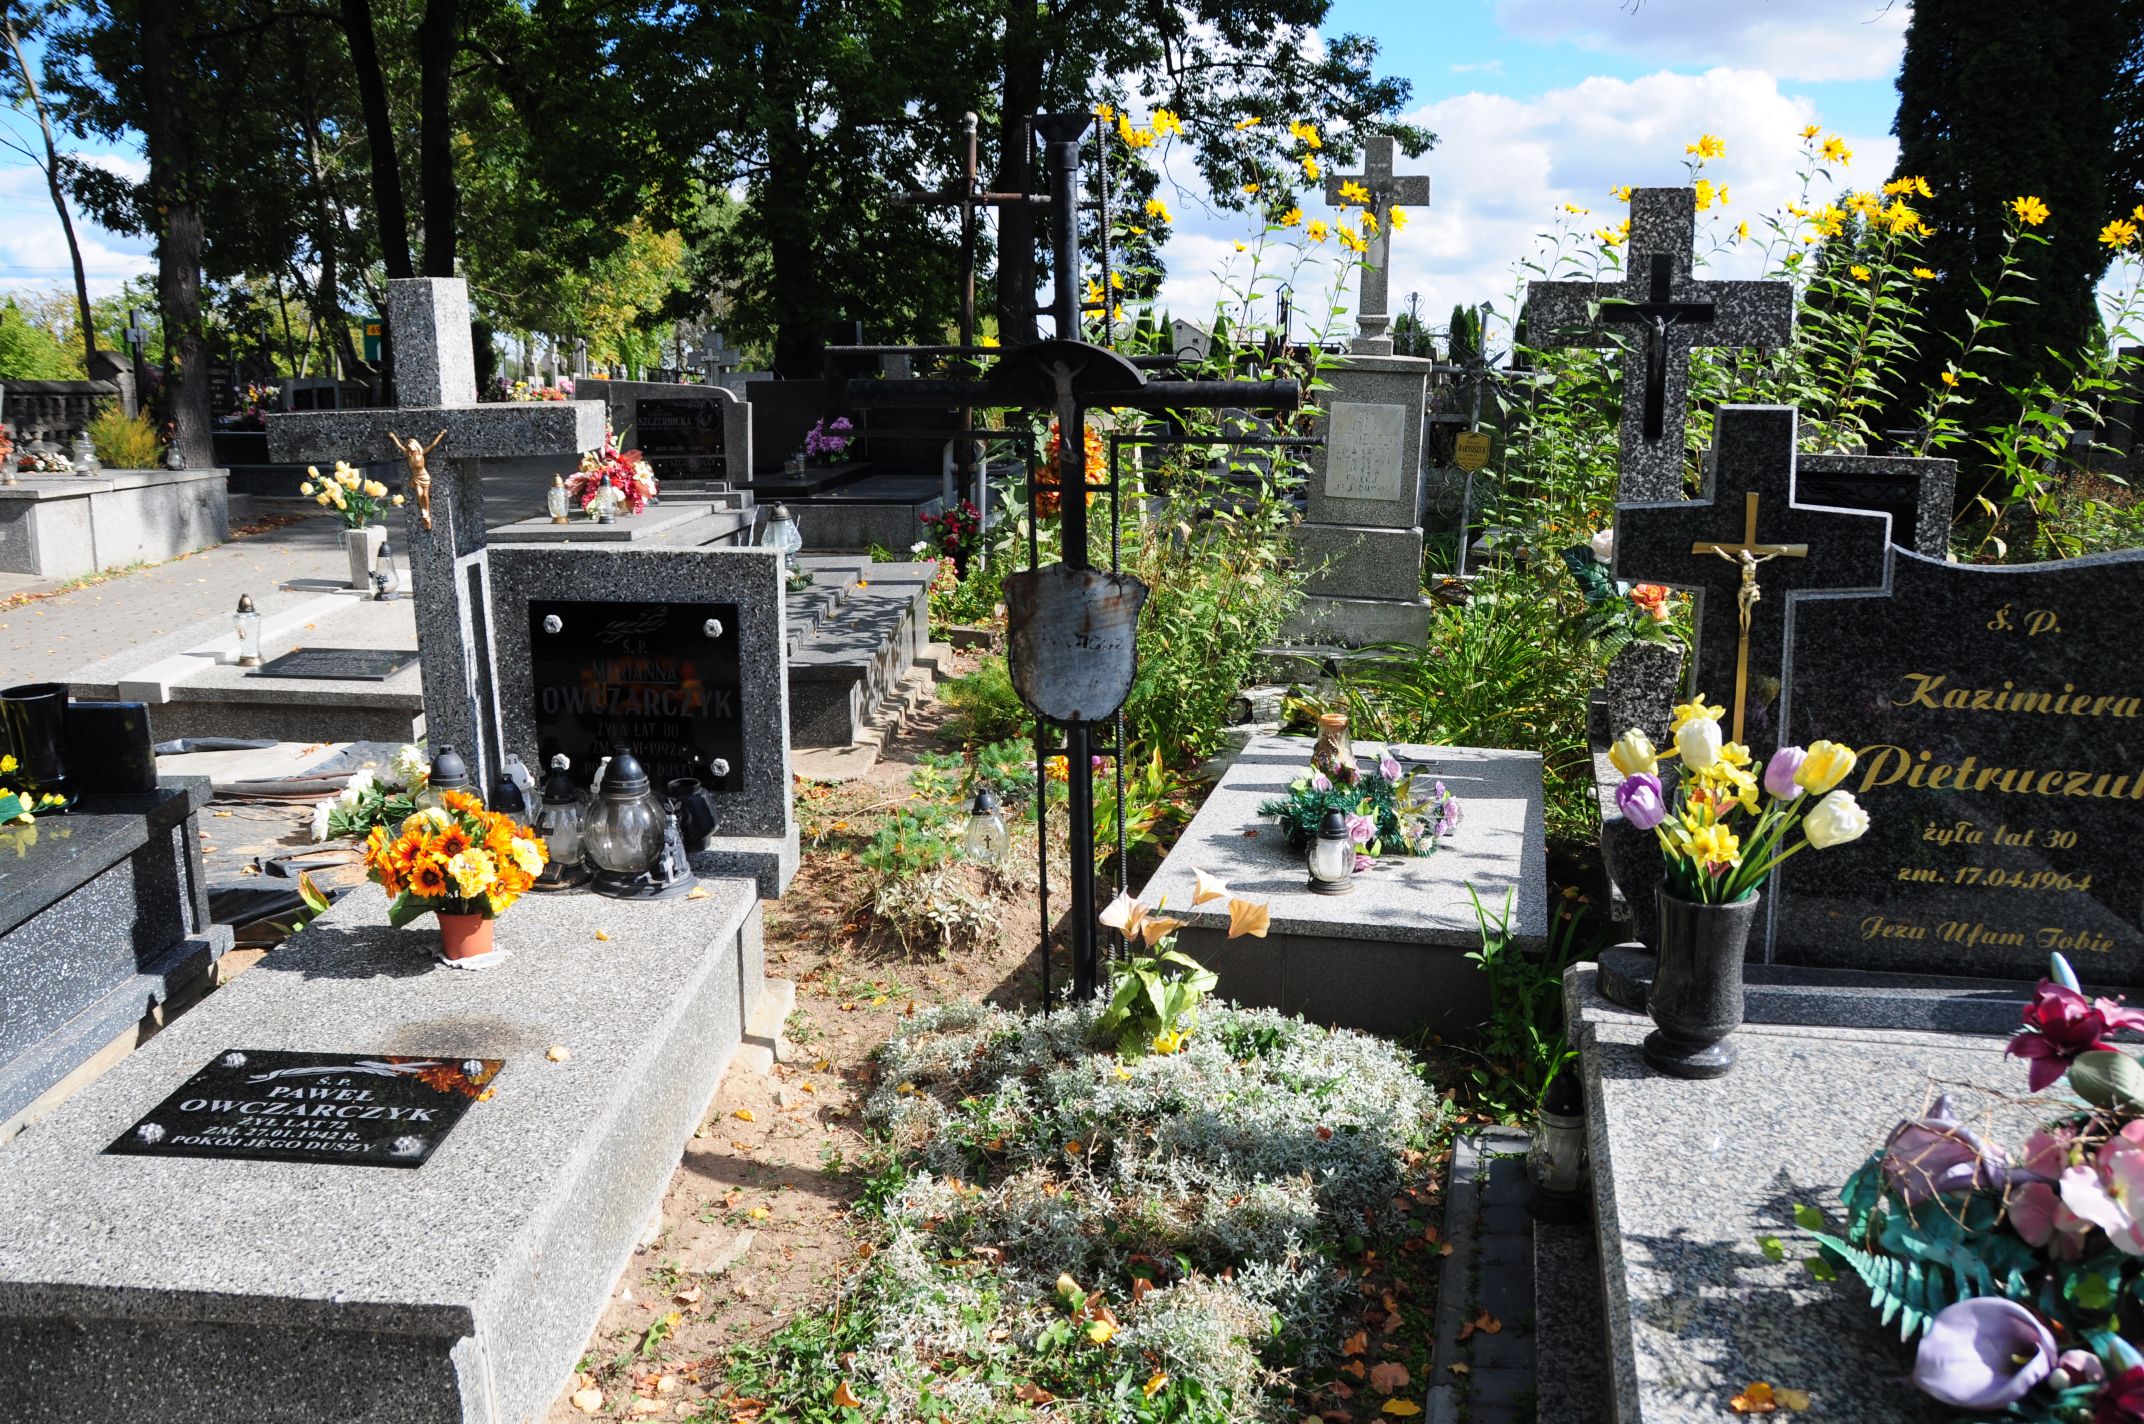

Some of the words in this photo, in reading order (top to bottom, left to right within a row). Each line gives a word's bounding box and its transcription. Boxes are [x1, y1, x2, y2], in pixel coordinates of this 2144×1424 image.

[592, 658, 678, 682] MARIANNA
[542, 686, 732, 718] OWCZARCZYK
[1890, 672, 2144, 718] Kazimiera
[634, 722, 656, 737] LAT
[1922, 821, 1982, 846] żyła
[1992, 824, 2034, 848] lat
[2042, 829, 2079, 850] 30
[1897, 866, 1945, 884] zm.
[1953, 866, 2092, 892] 17.04.1964
[1860, 916, 1927, 941] Jezu
[1936, 921, 2026, 948] Ufam
[2037, 926, 2116, 953] Tobie
[266, 1086, 375, 1102] PAWEŁ
[180, 1099, 439, 1122] OWCZARCZYK
[202, 1126, 239, 1136] ZM.
[244, 1128, 340, 1140] 27.01.1942
[342, 1132, 360, 1141] R.
[237, 1116, 279, 1126] ŻYŁ
[284, 1118, 326, 1128] LAT
[328, 1120, 349, 1130] 72
[170, 1136, 244, 1146] POKÓJ
[243, 1138, 302, 1149] JEGO
[304, 1141, 377, 1152] DUSZY
